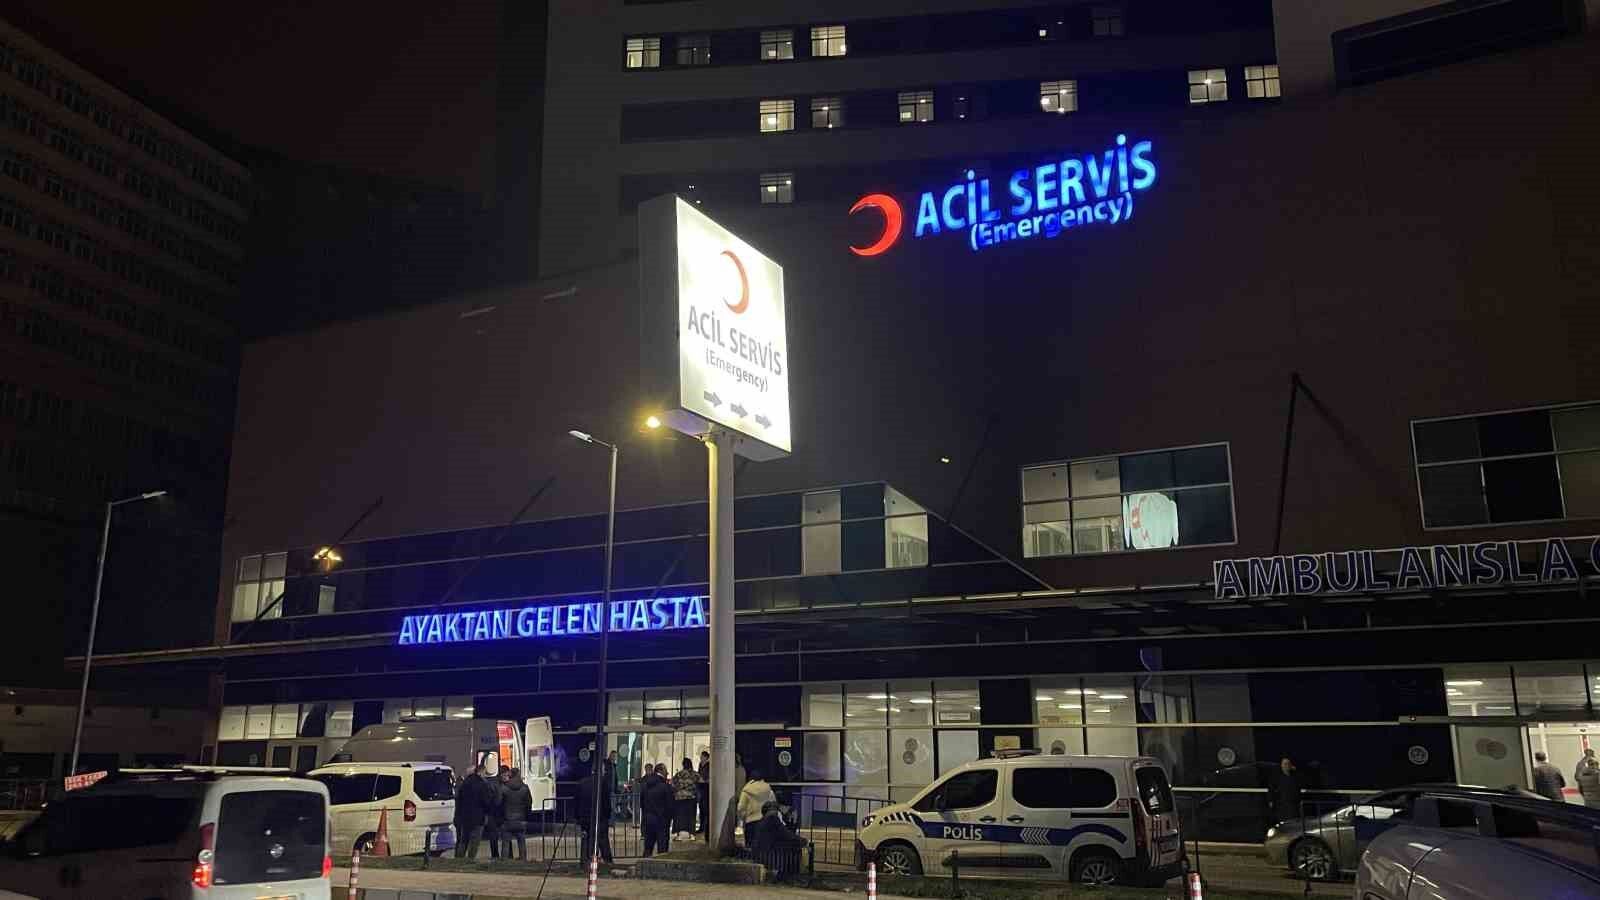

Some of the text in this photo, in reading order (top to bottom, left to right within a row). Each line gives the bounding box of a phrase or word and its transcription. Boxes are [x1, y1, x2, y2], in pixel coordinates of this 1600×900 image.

[915, 134, 1156, 237] ACİL SERVİS
[971, 191, 1133, 251] (Emergency)
[688, 305, 782, 376] ACİL SERVİS
[706, 346, 768, 393] (Emergency)
[1214, 538, 1577, 598] AMBULANSLA
[399, 596, 706, 645] AYAKTAN GELEN HASTA
[943, 825, 982, 840] POLİS
